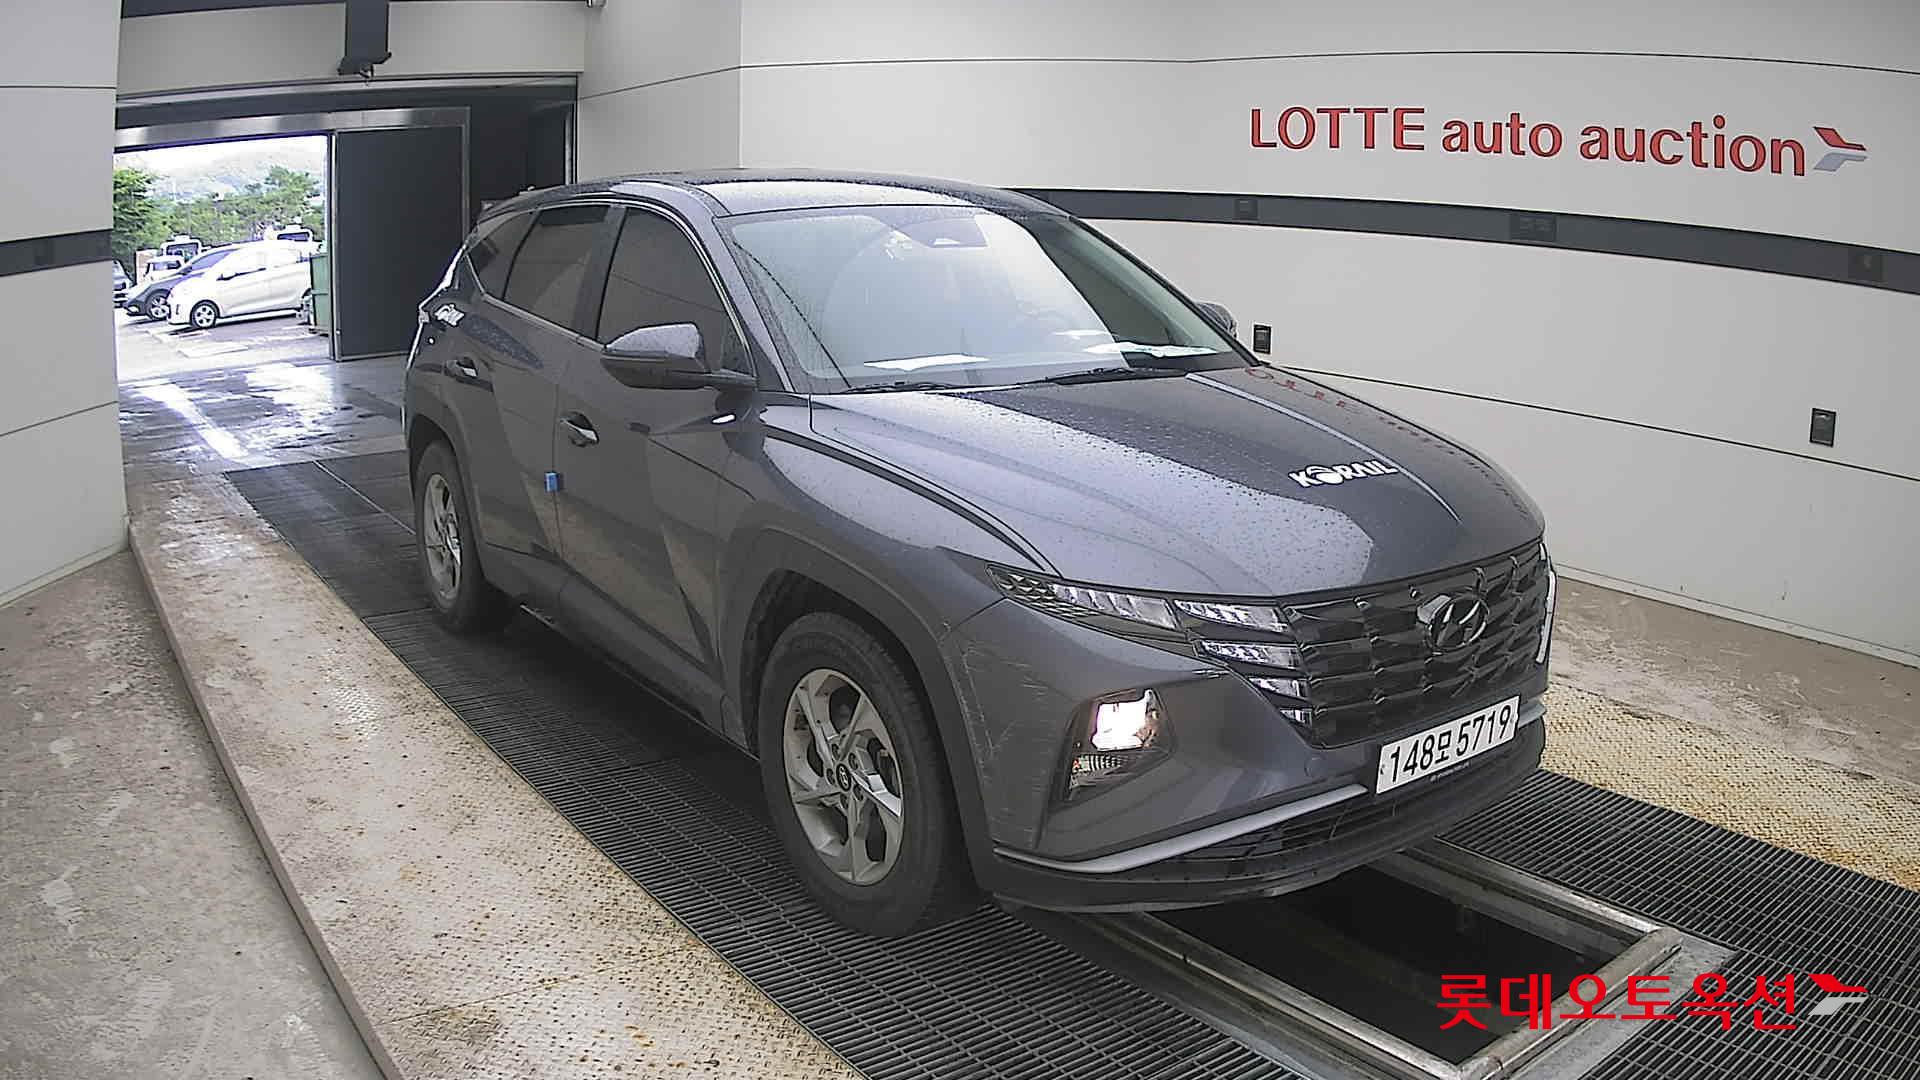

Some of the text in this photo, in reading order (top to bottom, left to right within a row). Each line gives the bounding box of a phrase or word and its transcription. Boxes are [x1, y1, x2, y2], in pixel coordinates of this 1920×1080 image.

[1251, 107, 1807, 176] LOTTE auto auction
[1289, 459, 1399, 487] KORAIL
[1456, 704, 1512, 757] 5719
